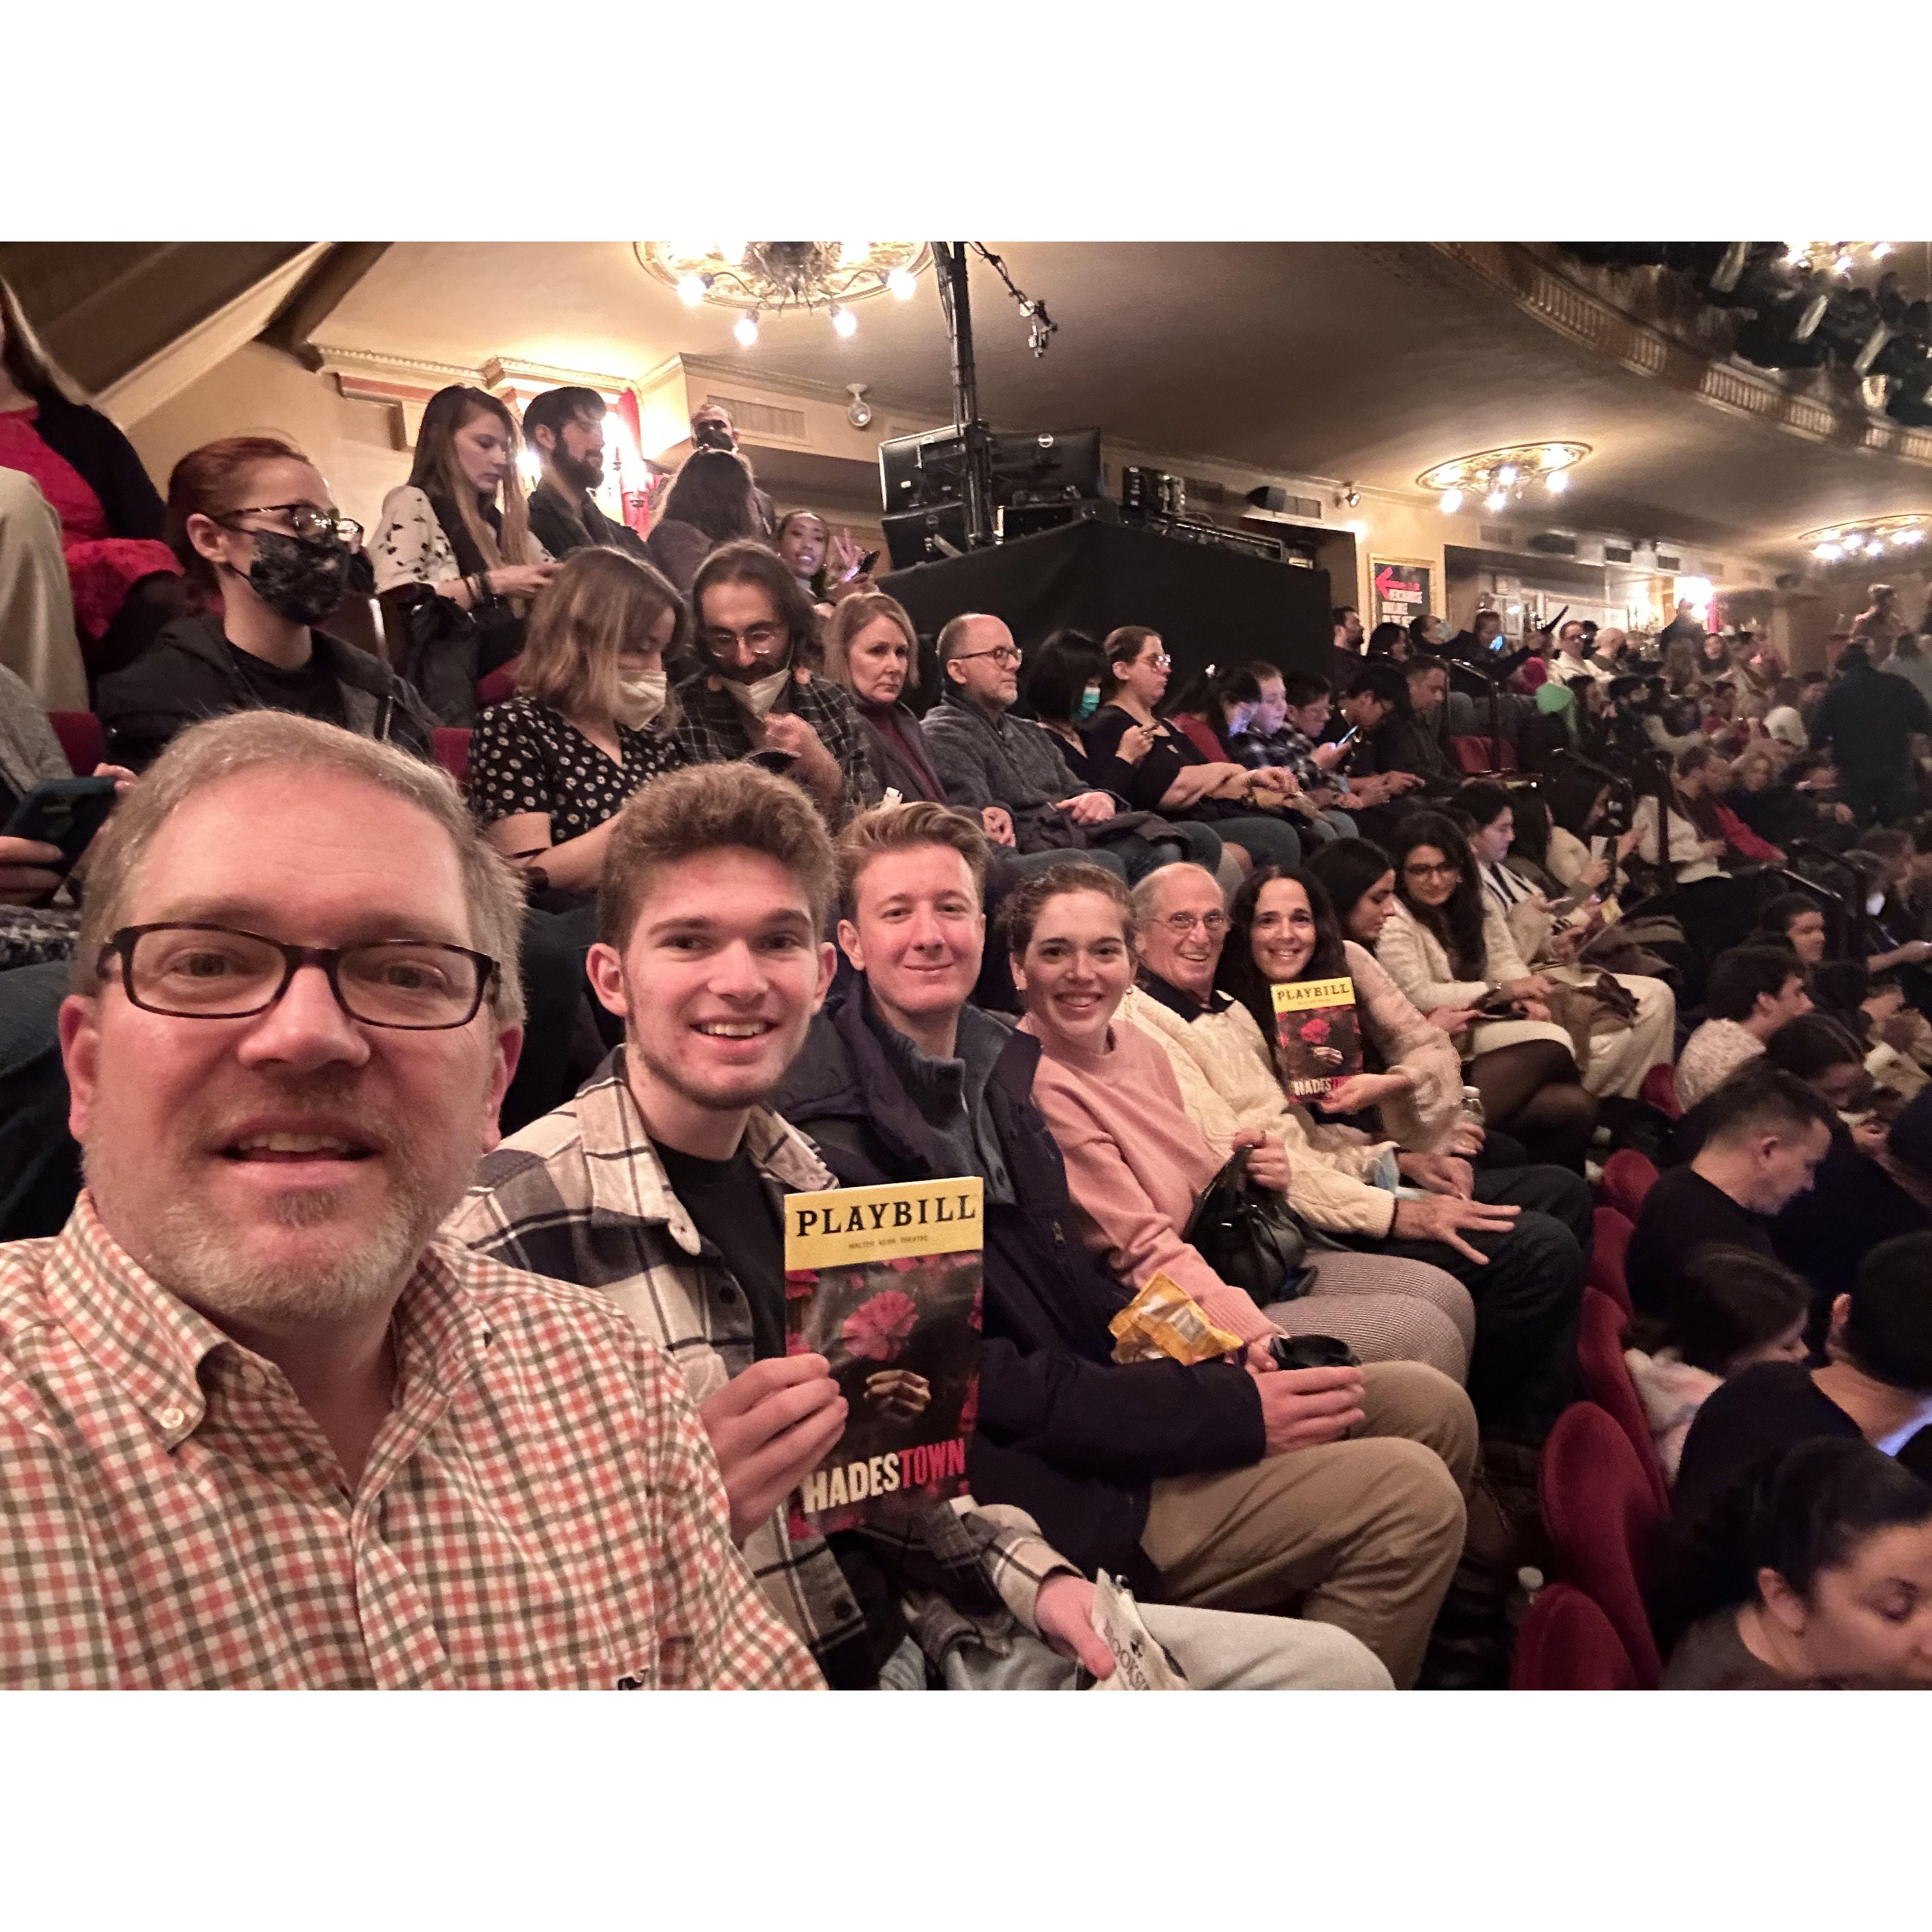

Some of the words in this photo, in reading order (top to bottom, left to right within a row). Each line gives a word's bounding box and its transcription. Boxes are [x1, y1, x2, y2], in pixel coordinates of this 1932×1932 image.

[1276, 984, 1350, 1001] PLAYBILL
[1293, 1075, 1351, 1096] HADEST
[796, 1195, 976, 1237] PLAYBILL
[801, 1438, 966, 1513] HADESTOWN
